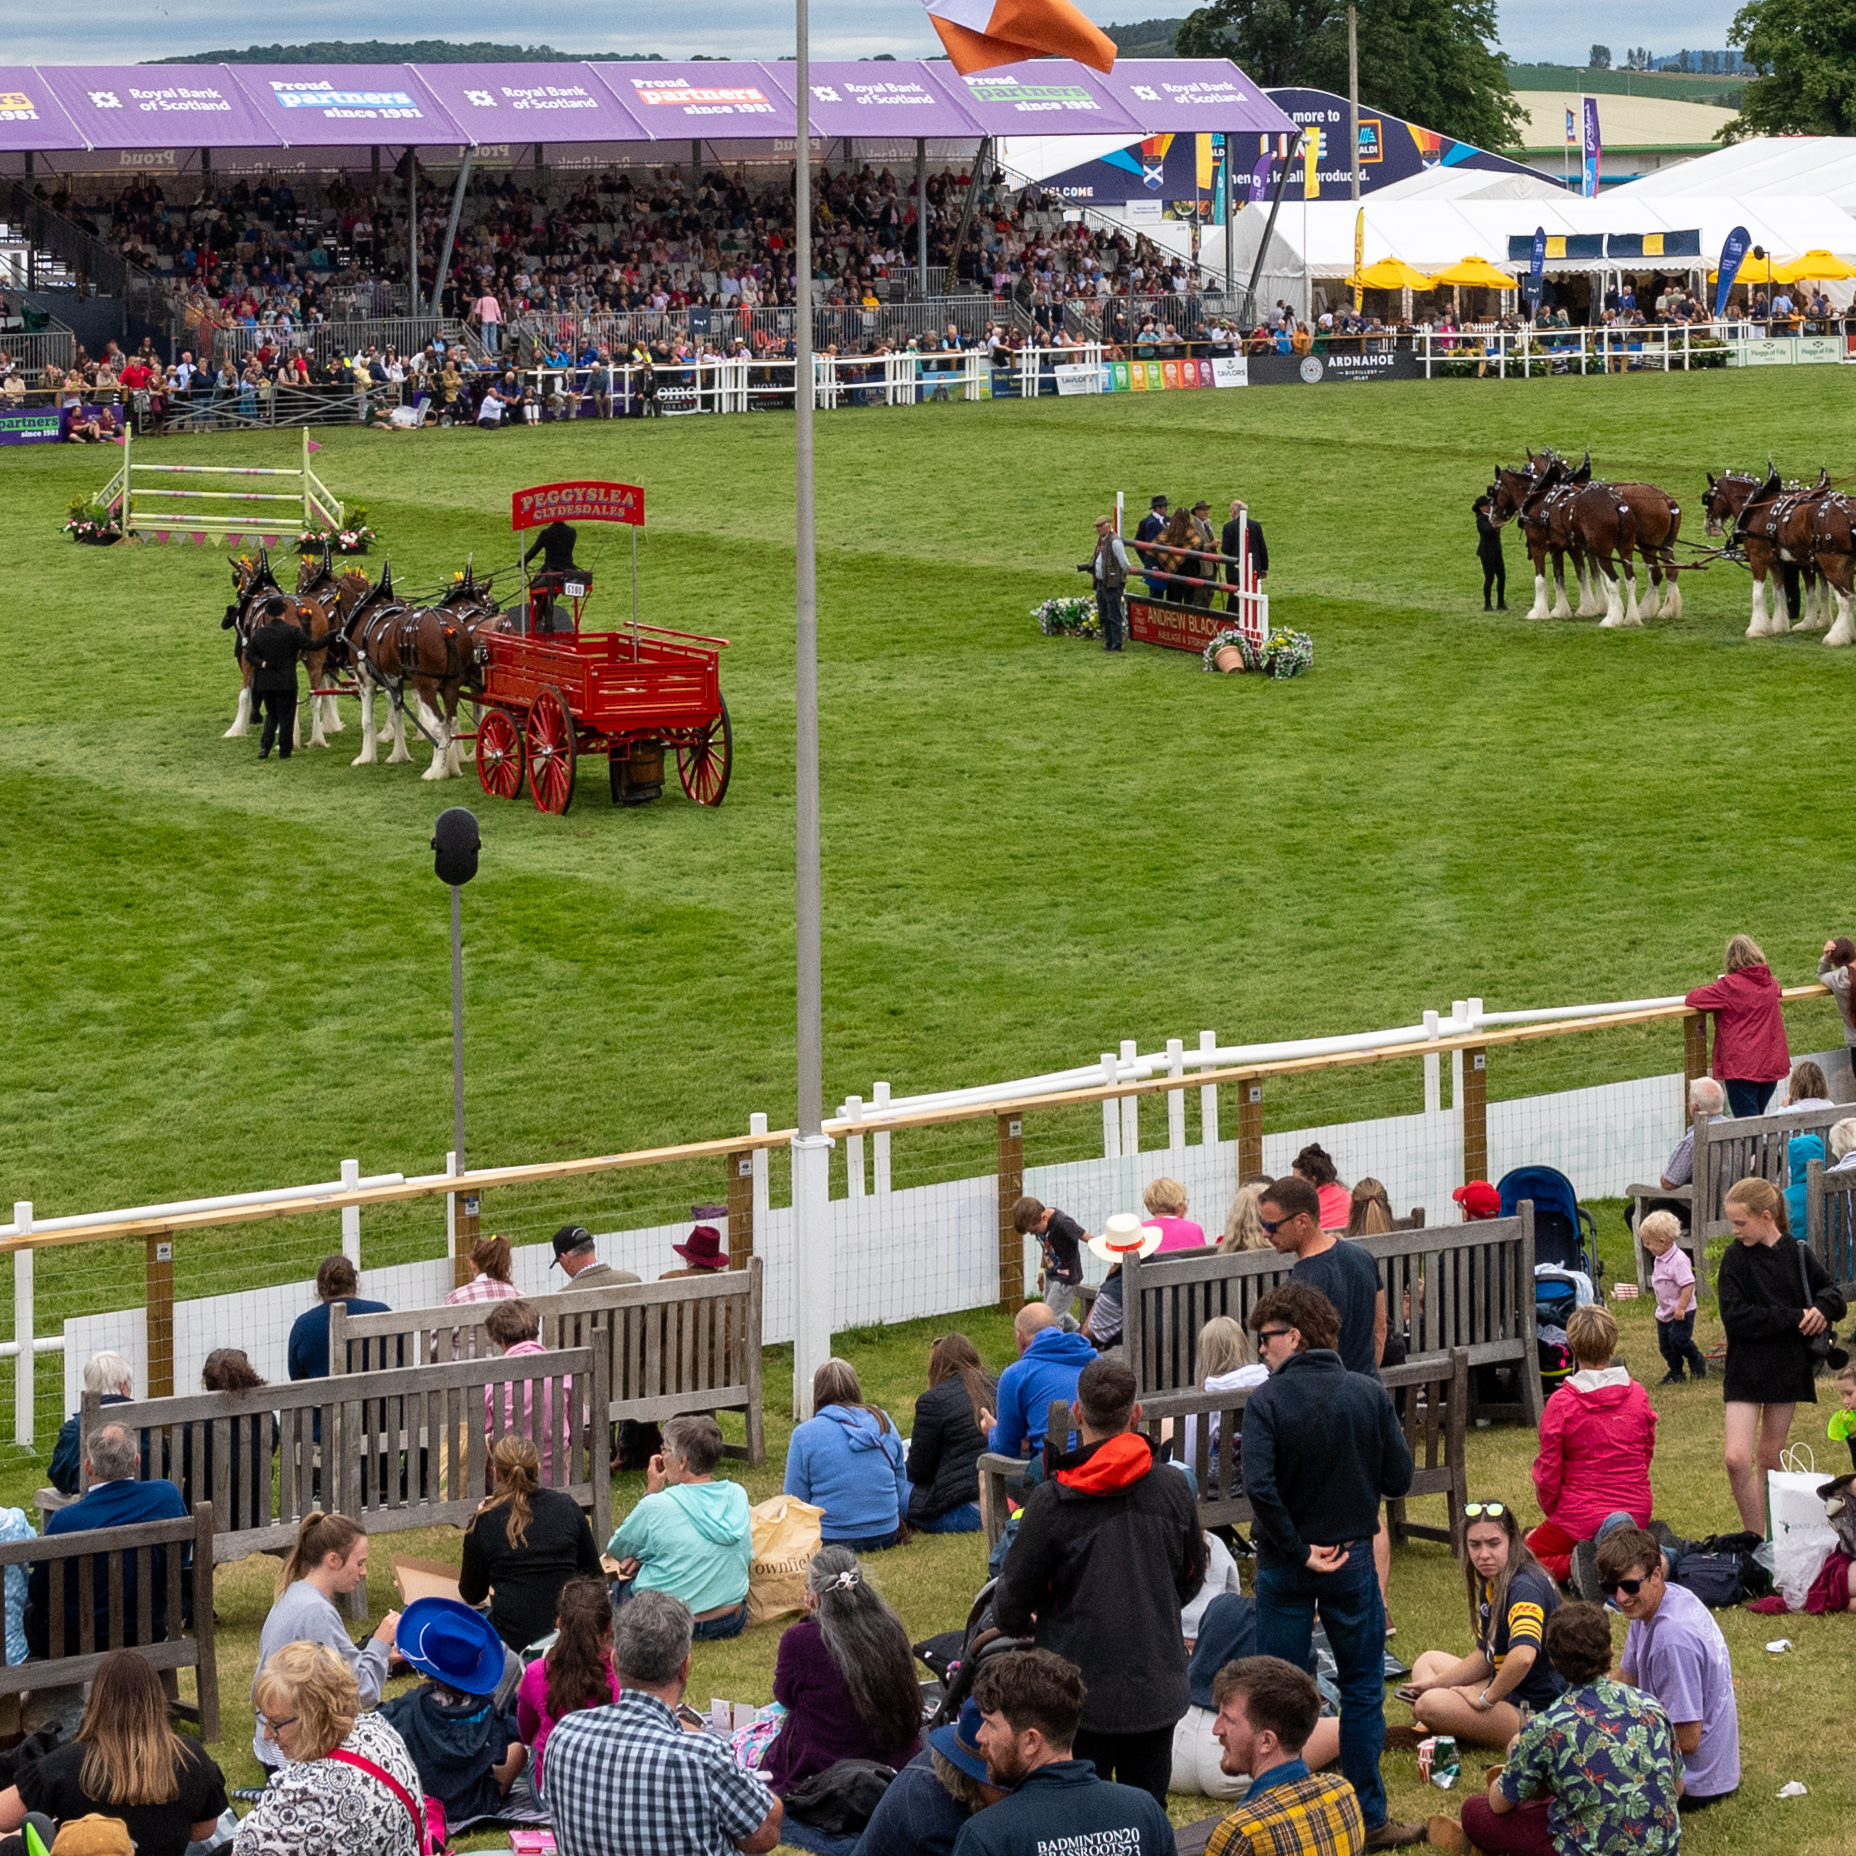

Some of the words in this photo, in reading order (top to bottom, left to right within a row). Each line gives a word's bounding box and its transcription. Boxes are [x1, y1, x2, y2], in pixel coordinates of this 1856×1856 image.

[269, 81, 334, 91] Proud
[630, 79, 691, 88] Proud
[962, 76, 1019, 85] Proud
[501, 87, 545, 100] Royal
[545, 87, 589, 98] Bank
[844, 83, 885, 96] Royal
[886, 84, 925, 94] Bank
[975, 86, 1084, 101] partners
[1162, 83, 1201, 94] Royal
[1202, 82, 1237, 92] Bank
[129, 88, 176, 101] Royal
[178, 89, 222, 99] Bank
[279, 92, 413, 108] partners
[643, 89, 764, 104] partners
[856, 94, 876, 105] of
[876, 94, 935, 104] Scotland
[1175, 93, 1192, 104] of
[1192, 93, 1248, 104] Scotland
[139, 100, 163, 112] of
[163, 100, 231, 111] Scotland
[513, 98, 533, 109] of
[533, 98, 599, 109] Scotland
[684, 105, 733, 114] since
[734, 103, 776, 113] 1981
[1015, 102, 1061, 111] since
[1062, 100, 1101, 110] 1981
[324, 107, 379, 118] since
[379, 106, 423, 118] 1981
[1292, 111, 1324, 123] more
[1327, 109, 1341, 123] to
[1328, 355, 1395, 367] ARDNAHOE
[521, 488, 635, 512] PEGGYSLEA
[532, 505, 626, 521] CLYDESDALES
[1147, 606, 1187, 631] ANDREW
[1188, 614, 1219, 638] BLACK
[750, 1553, 812, 1576] ownfiel
[1037, 1829, 1123, 1854] BADMINTON
